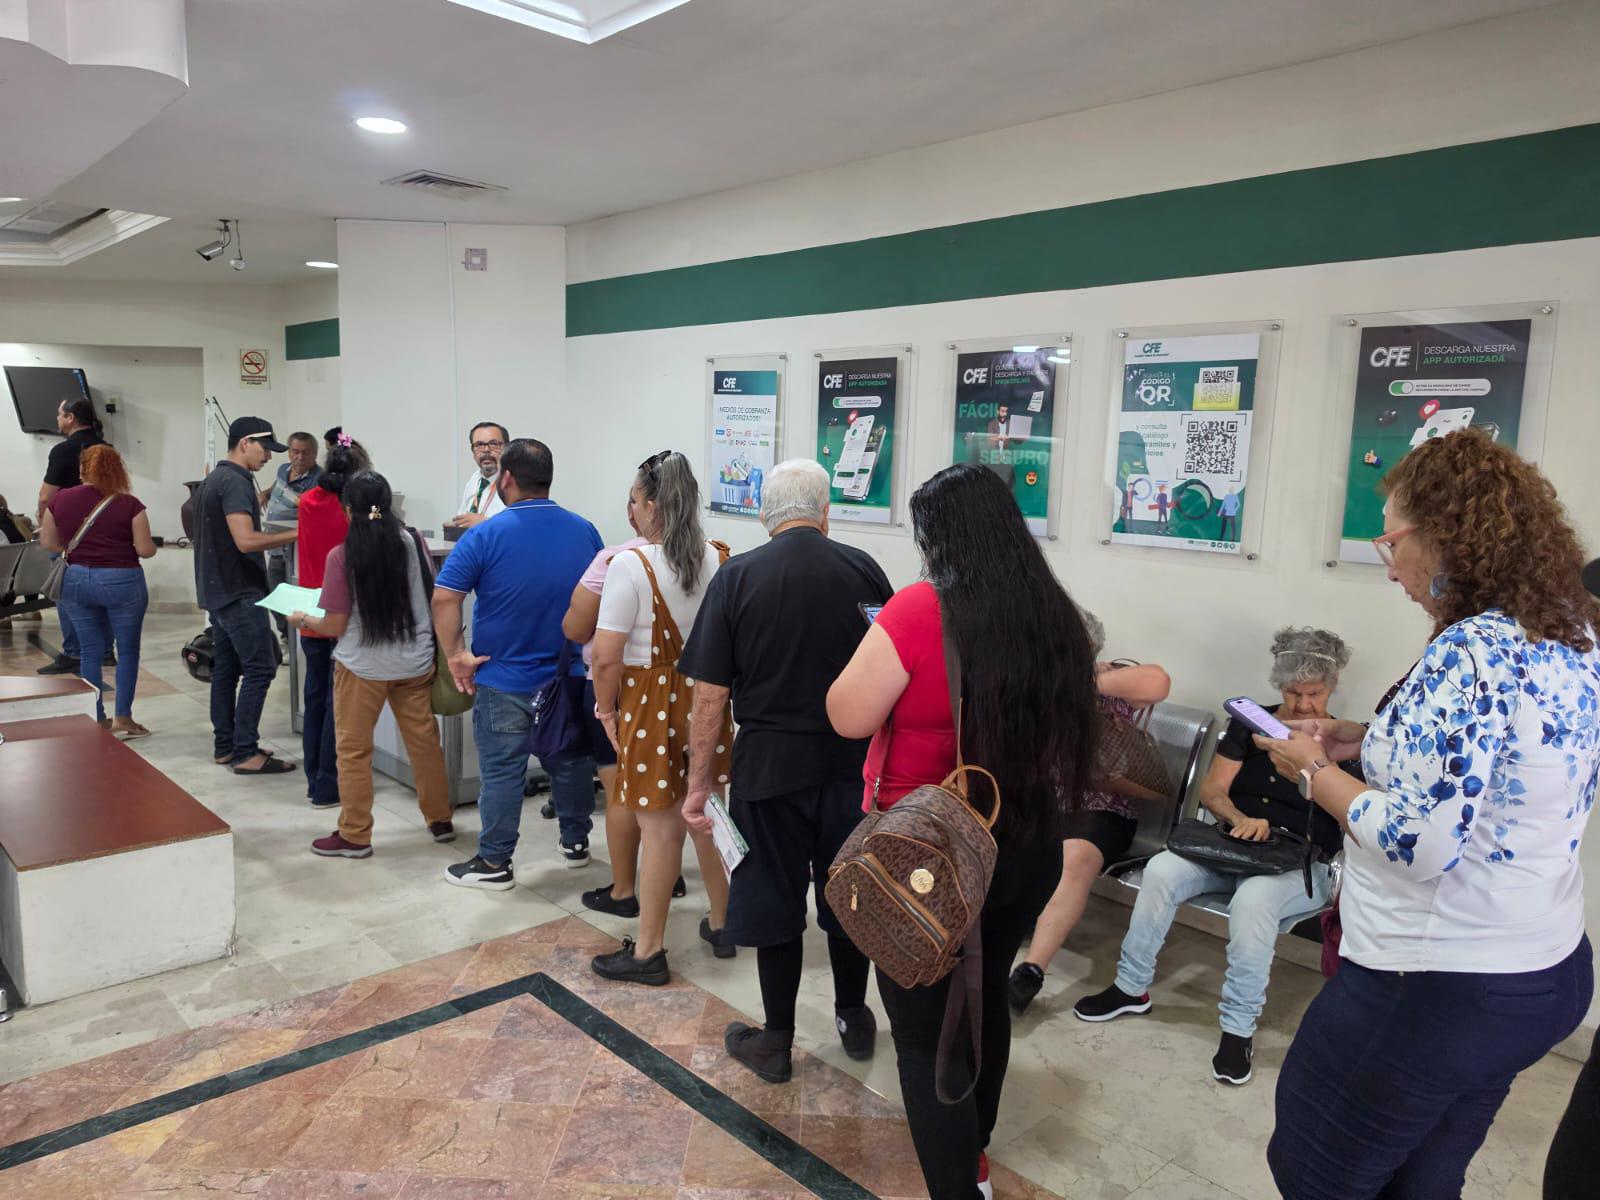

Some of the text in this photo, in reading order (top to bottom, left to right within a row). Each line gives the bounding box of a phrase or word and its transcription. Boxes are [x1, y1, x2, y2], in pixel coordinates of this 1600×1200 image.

[1143, 342, 1162, 353] CFE
[1424, 344, 1516, 355] DESCARGA NUESTRA
[1370, 346, 1411, 367] CFE
[1423, 355, 1505, 365] APP AUTORIZADA
[723, 377, 737, 389] CFE
[823, 374, 843, 389] CFE
[963, 368, 988, 384] CFE
[1140, 385, 1171, 405] QR
[979, 449, 1049, 465] SEGURO
